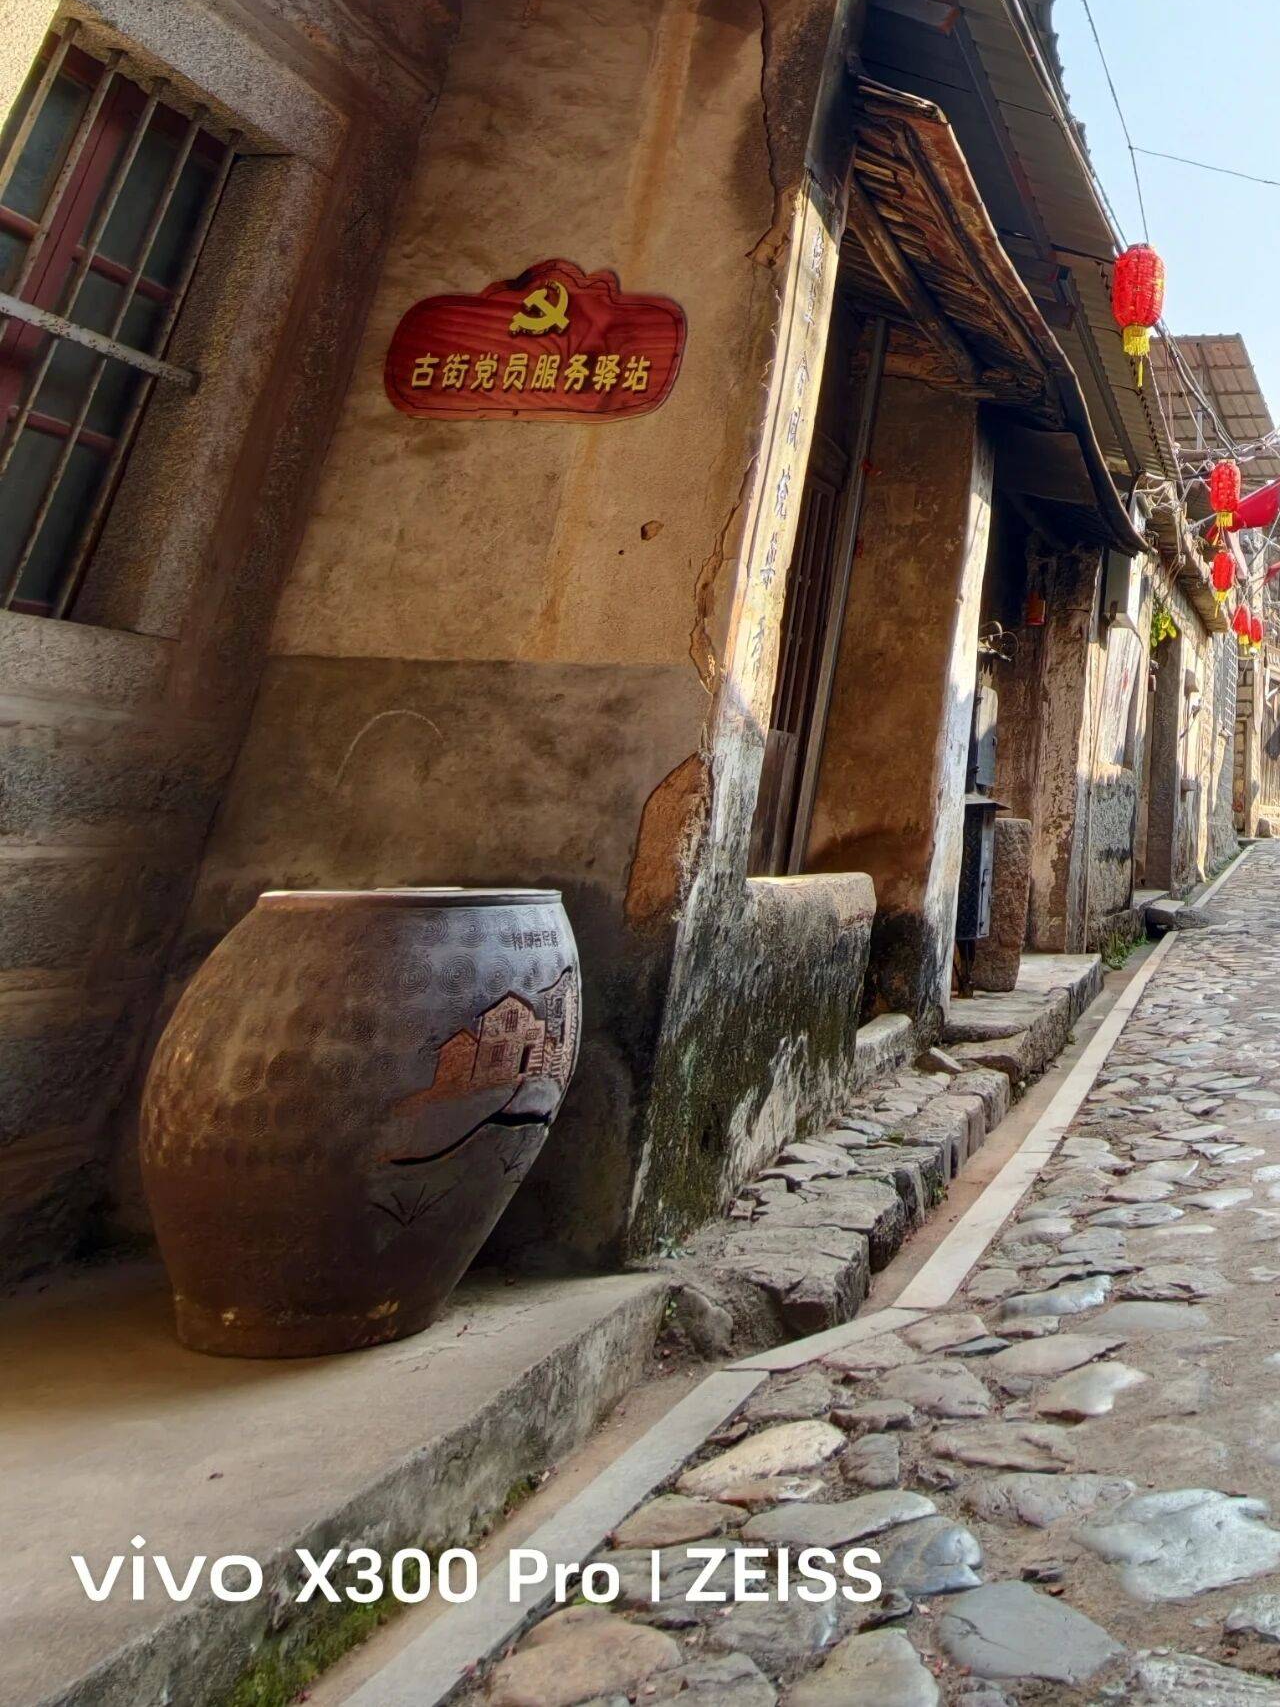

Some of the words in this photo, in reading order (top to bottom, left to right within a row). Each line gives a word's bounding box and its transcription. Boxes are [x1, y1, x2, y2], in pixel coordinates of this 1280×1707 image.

[410, 352, 651, 392] 古街党员服务驿站
